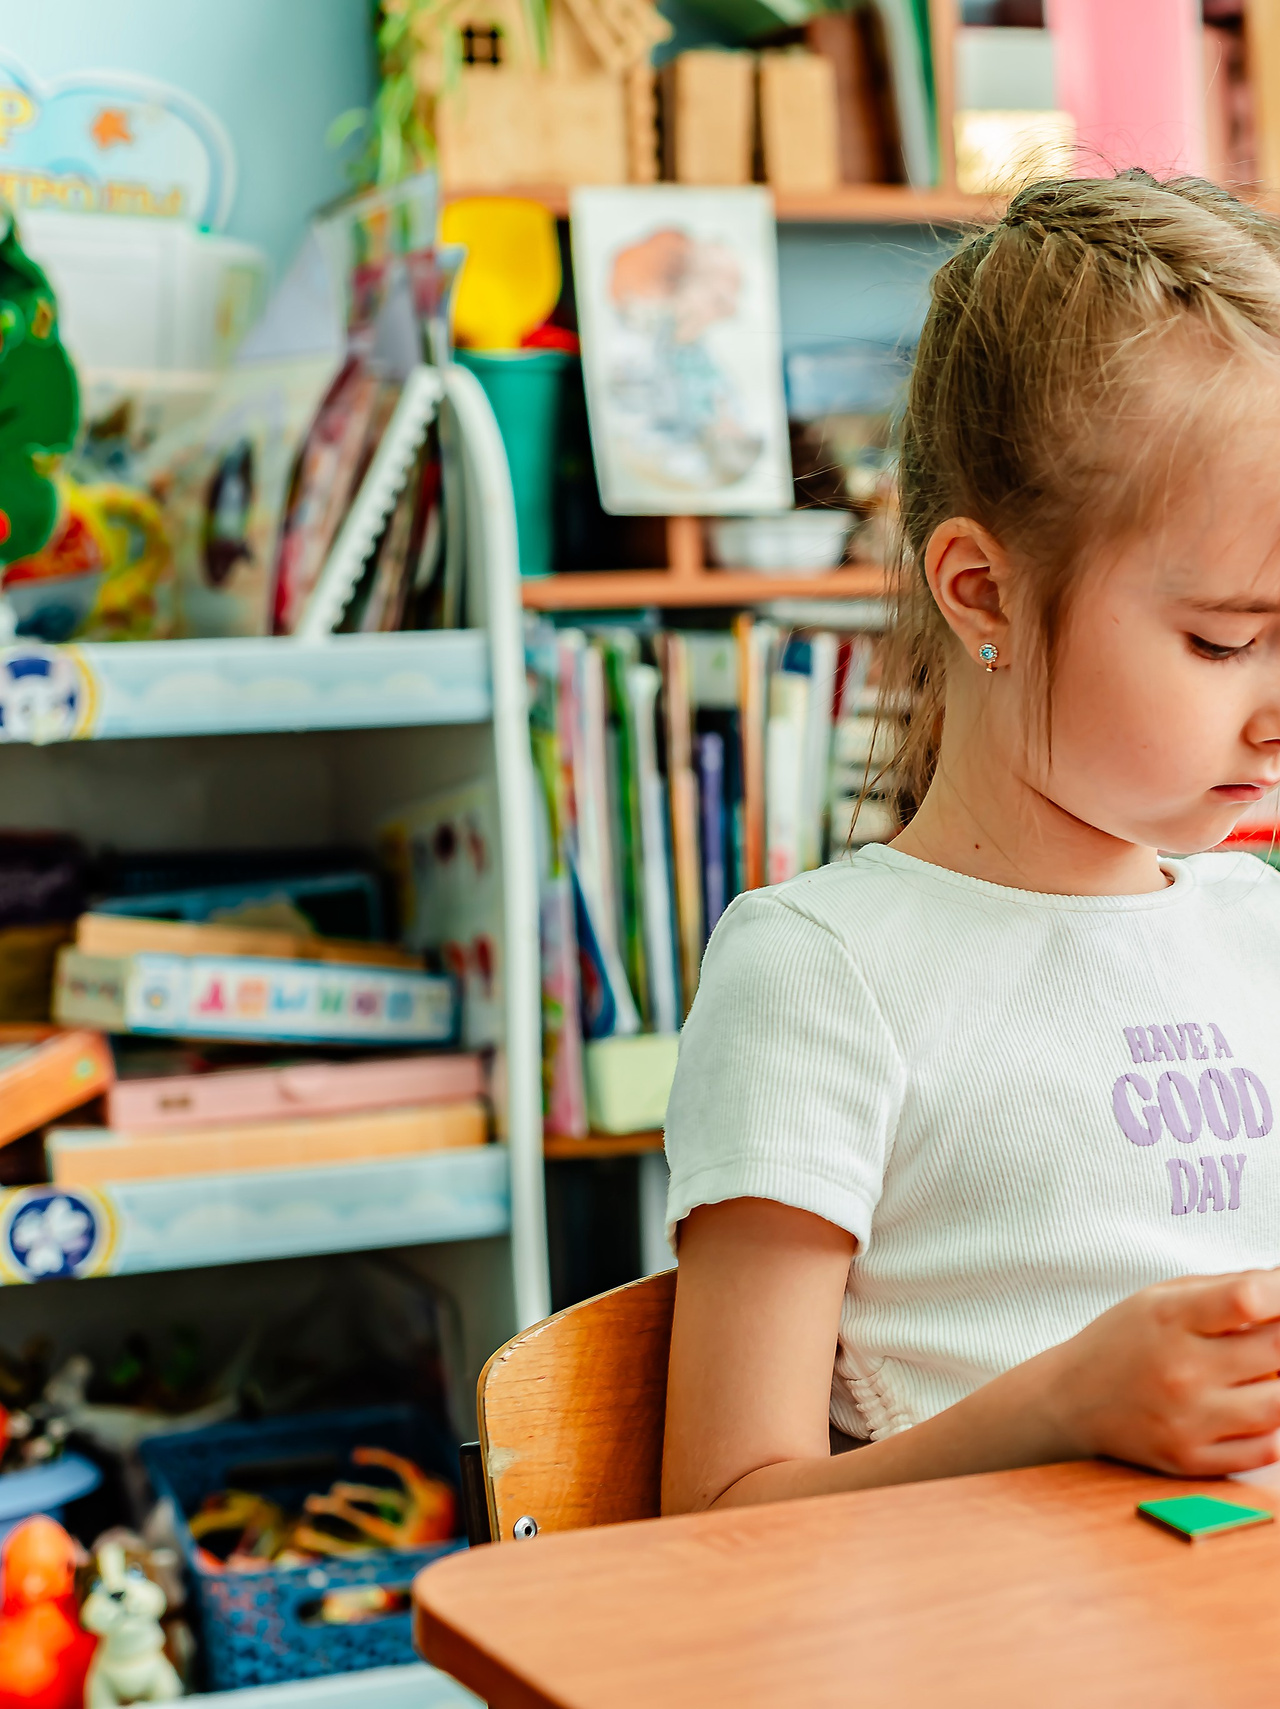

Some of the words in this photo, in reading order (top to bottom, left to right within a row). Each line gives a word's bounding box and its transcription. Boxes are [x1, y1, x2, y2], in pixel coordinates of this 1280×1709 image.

[1122, 1023, 1209, 1063] HAVE
[1207, 1023, 1233, 1059] A
[1112, 1067, 1273, 1147] GOOD
[1166, 1153, 1247, 1215] DAY
